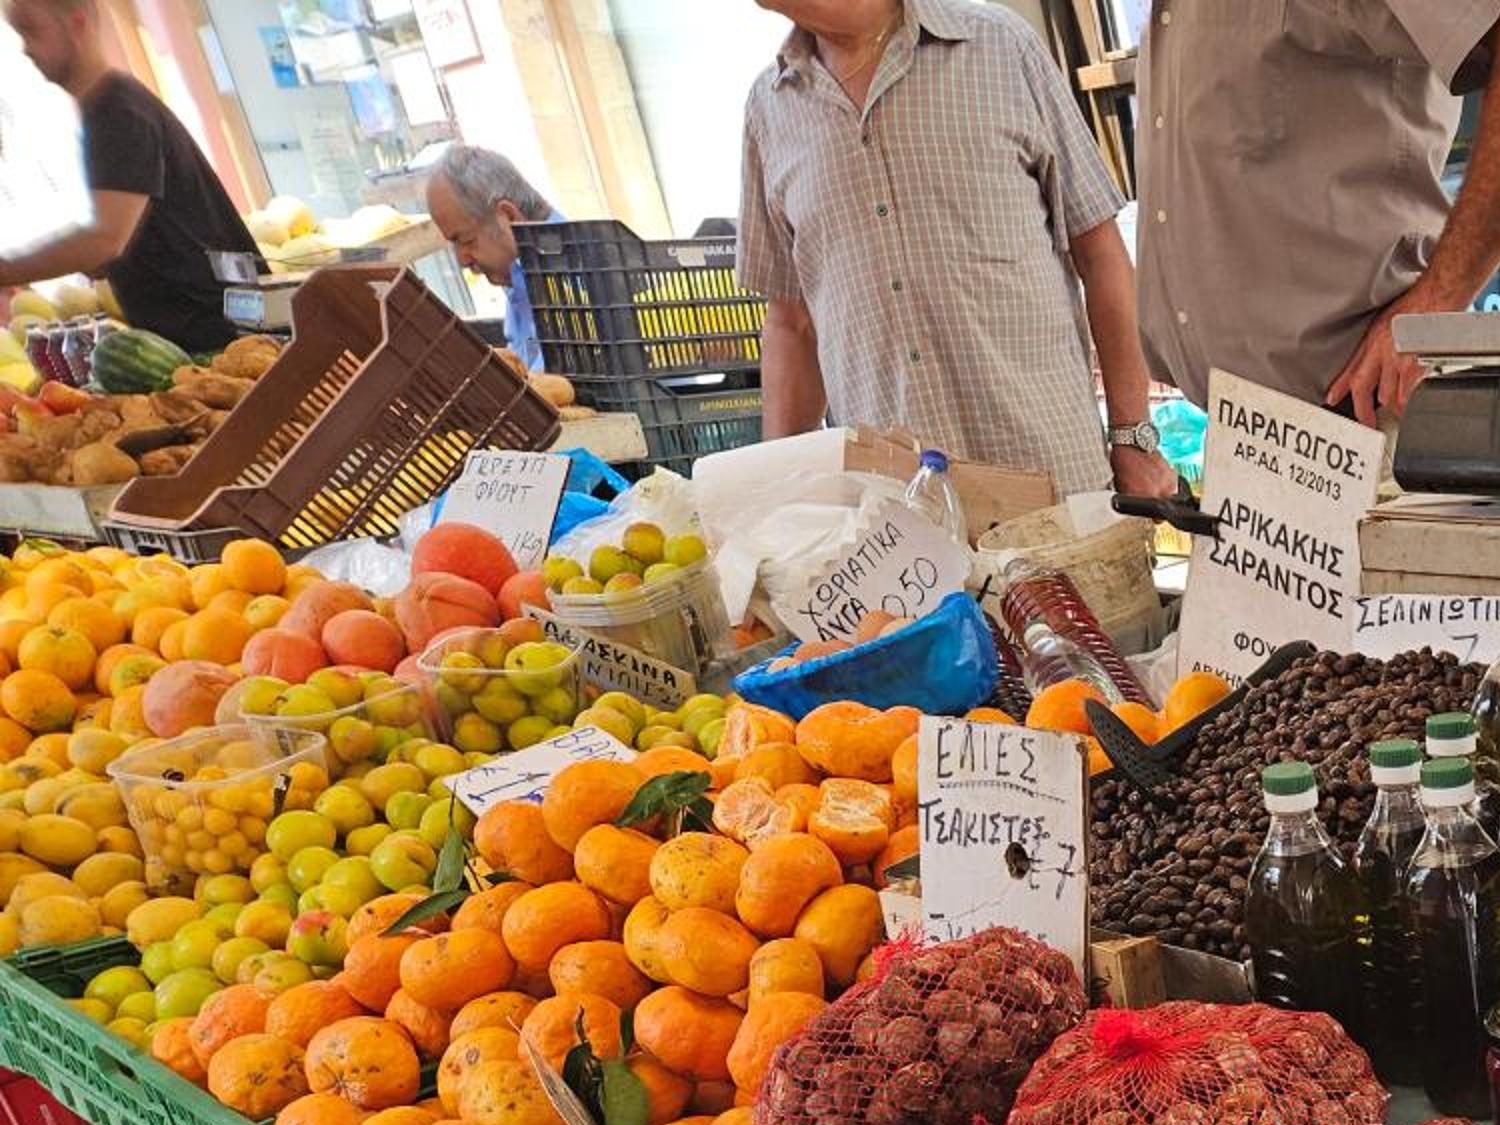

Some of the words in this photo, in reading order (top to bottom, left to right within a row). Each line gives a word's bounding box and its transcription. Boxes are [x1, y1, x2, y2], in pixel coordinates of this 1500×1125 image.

[1218, 398, 1366, 481] ΠΑΡΑΓΩΓΟΣ:
[1234, 441, 1283, 477] ΑΡ.ΑΔ.
[1288, 463, 1342, 501] 12/2013
[797, 521, 905, 628] ΧΩΡΙΑΤΙΚΑ
[1209, 533, 1343, 619] ΣΑΡΑΝΤΟΣ
[1215, 497, 1344, 578] ΔΡΙΚΑΚΗΣ
[937, 723, 1038, 784] ΕΛΙΕΣ
[1056, 841, 1078, 900] 7
